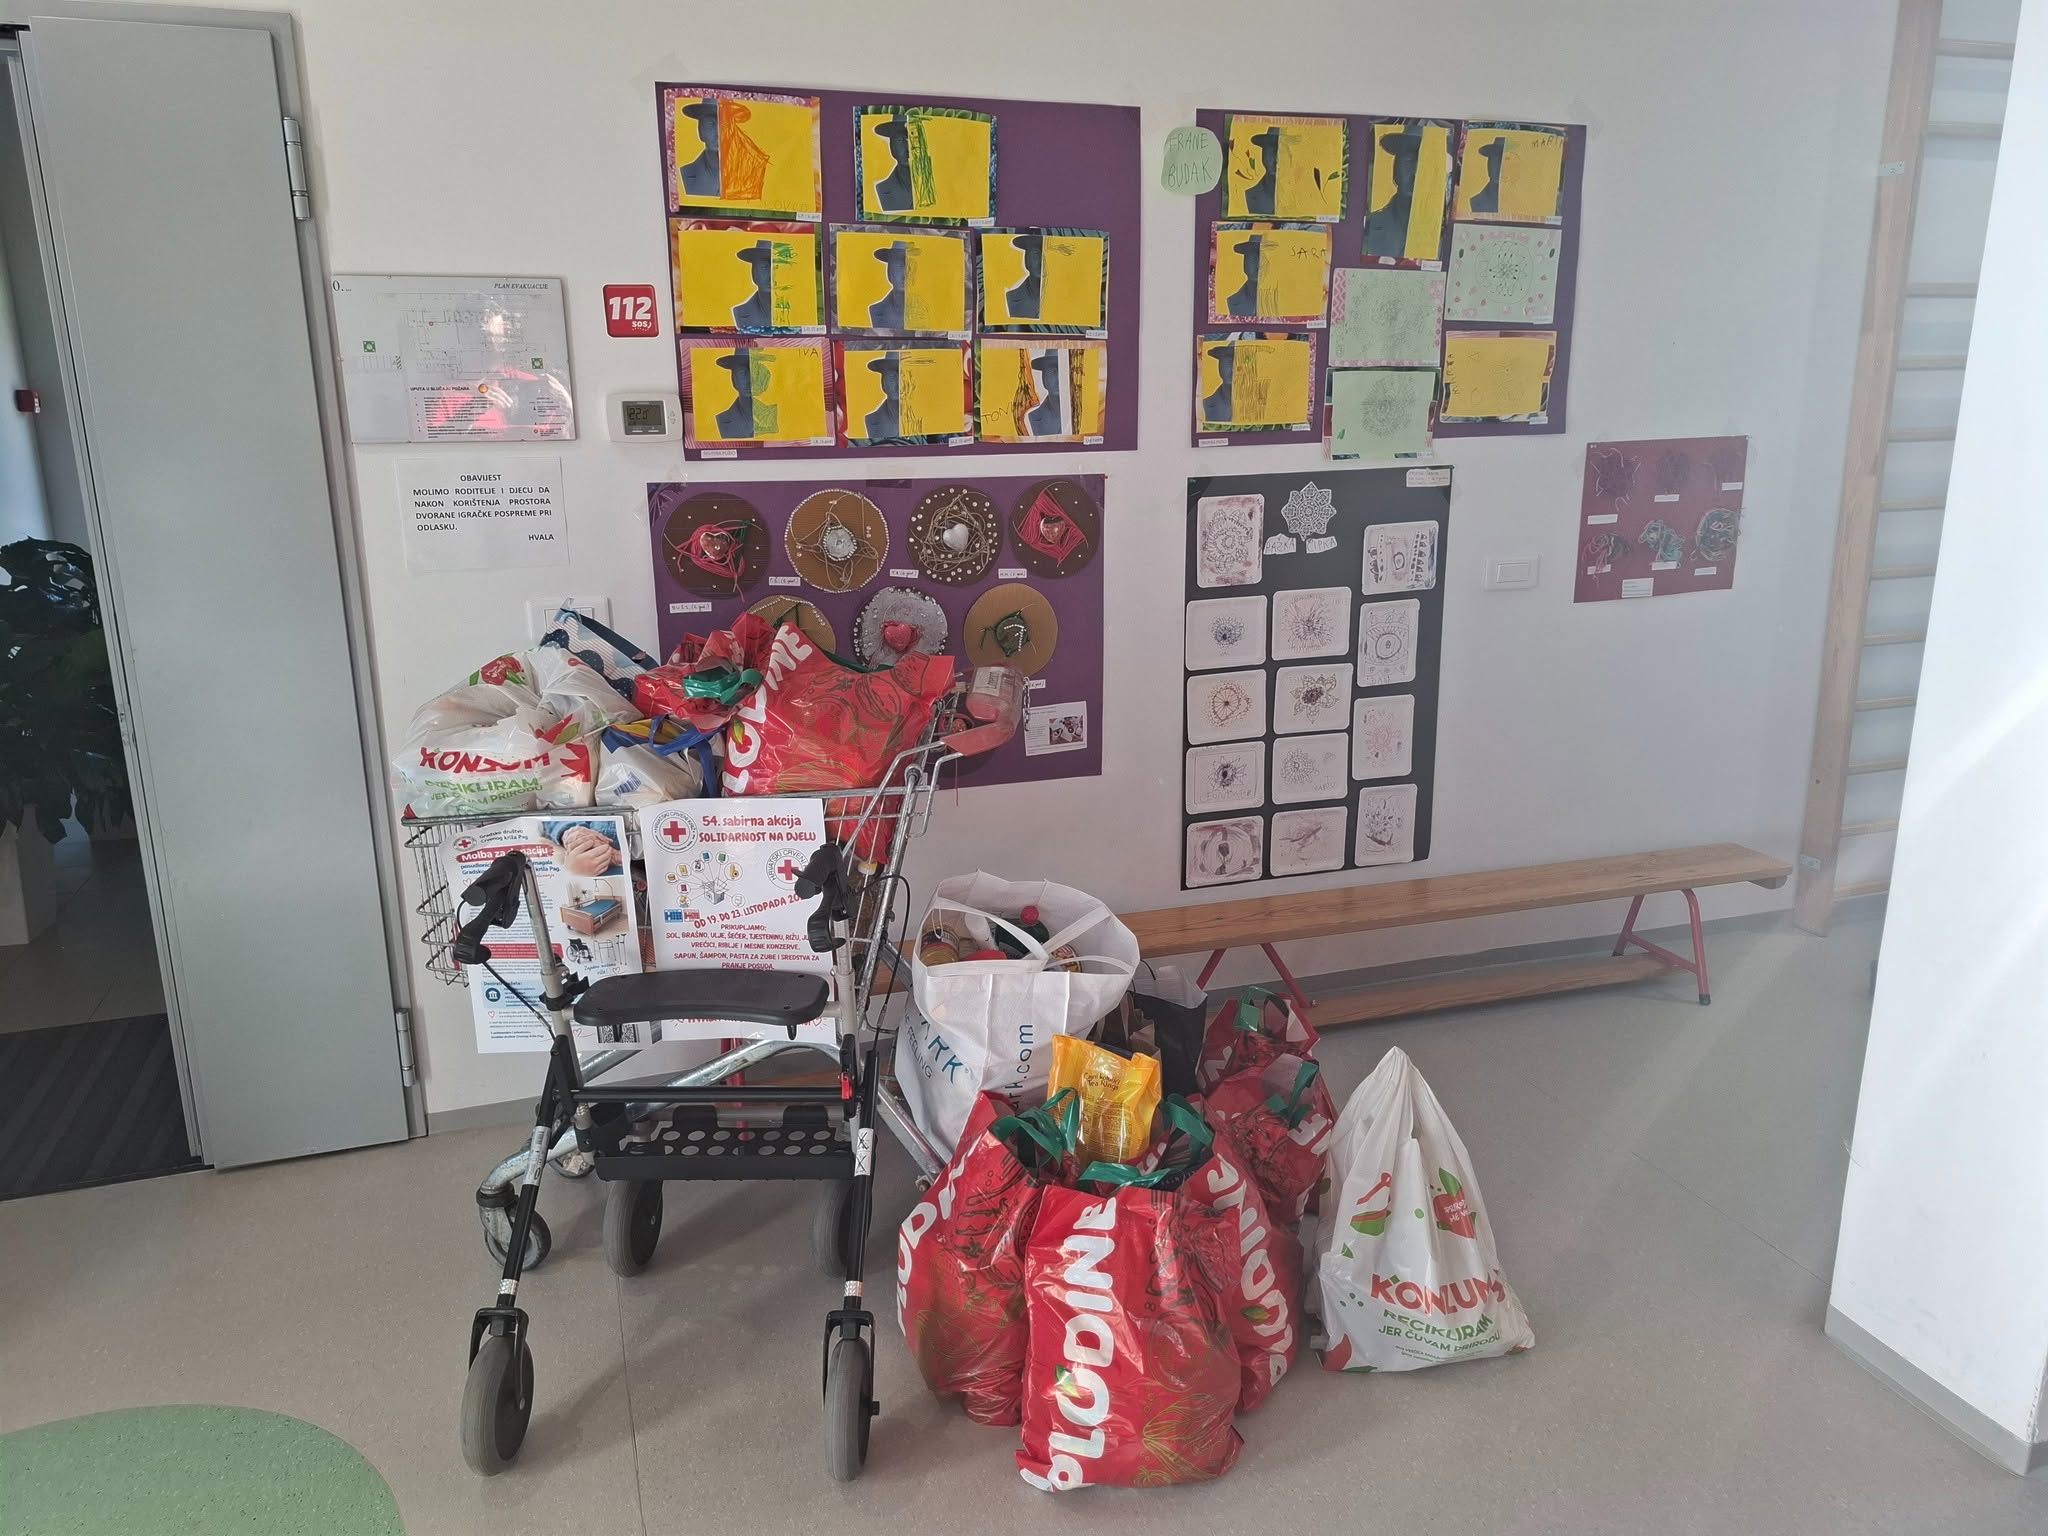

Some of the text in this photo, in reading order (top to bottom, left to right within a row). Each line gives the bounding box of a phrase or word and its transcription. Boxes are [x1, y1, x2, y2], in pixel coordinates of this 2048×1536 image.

[1168, 132, 1209, 152] FRANE
[1168, 157, 1212, 187] BUDAK
[1290, 245, 1327, 259] SARA
[609, 296, 652, 321] 112
[632, 320, 648, 328] SOS
[798, 347, 819, 358] IVA
[982, 400, 1013, 424] TONI
[460, 474, 501, 482] OBAVIJEST
[413, 488, 449, 496] MOLIMO
[455, 487, 496, 495] RODITELJE
[509, 486, 533, 494] DJECU
[538, 486, 550, 494] DA
[414, 500, 444, 508] NAKON
[453, 498, 500, 507] KORIŠTENJA
[416, 512, 456, 520] DVORANE
[458, 510, 492, 518] IGRAČKE
[417, 524, 458, 532] ODLASKU.
[490, 785, 543, 802] PRIRODU
[702, 815, 802, 830] 54. sabirna akcija
[699, 832, 816, 842] SOLIDARNOST NA DJELU
[461, 851, 493, 862] Molba
[494, 850, 506, 858] za
[768, 850, 806, 880] HRVATSKI CRVENI
[694, 919, 707, 929] OD
[707, 916, 720, 925] 19.
[720, 912, 730, 922] DO
[731, 909, 743, 919] 23.
[744, 898, 786, 916] LISTOPADA
[728, 932, 748, 940] ŠEĆER,
[786, 933, 800, 941] RIŽU,
[674, 952, 698, 960] SAPUN,
[700, 951, 728, 960] ŠAMPON,
[730, 952, 750, 960] PASTA
[908, 1026, 932, 1078] FEELING
[1101, 1080, 1119, 1091] Rings
[1370, 1269, 1506, 1316] KONZUM
[1384, 1309, 1493, 1342] RECIKLIRAM
[1020, 1196, 1117, 1492] PLODINE
[1378, 1325, 1501, 1352] JER ČUVAM PRIRODU
